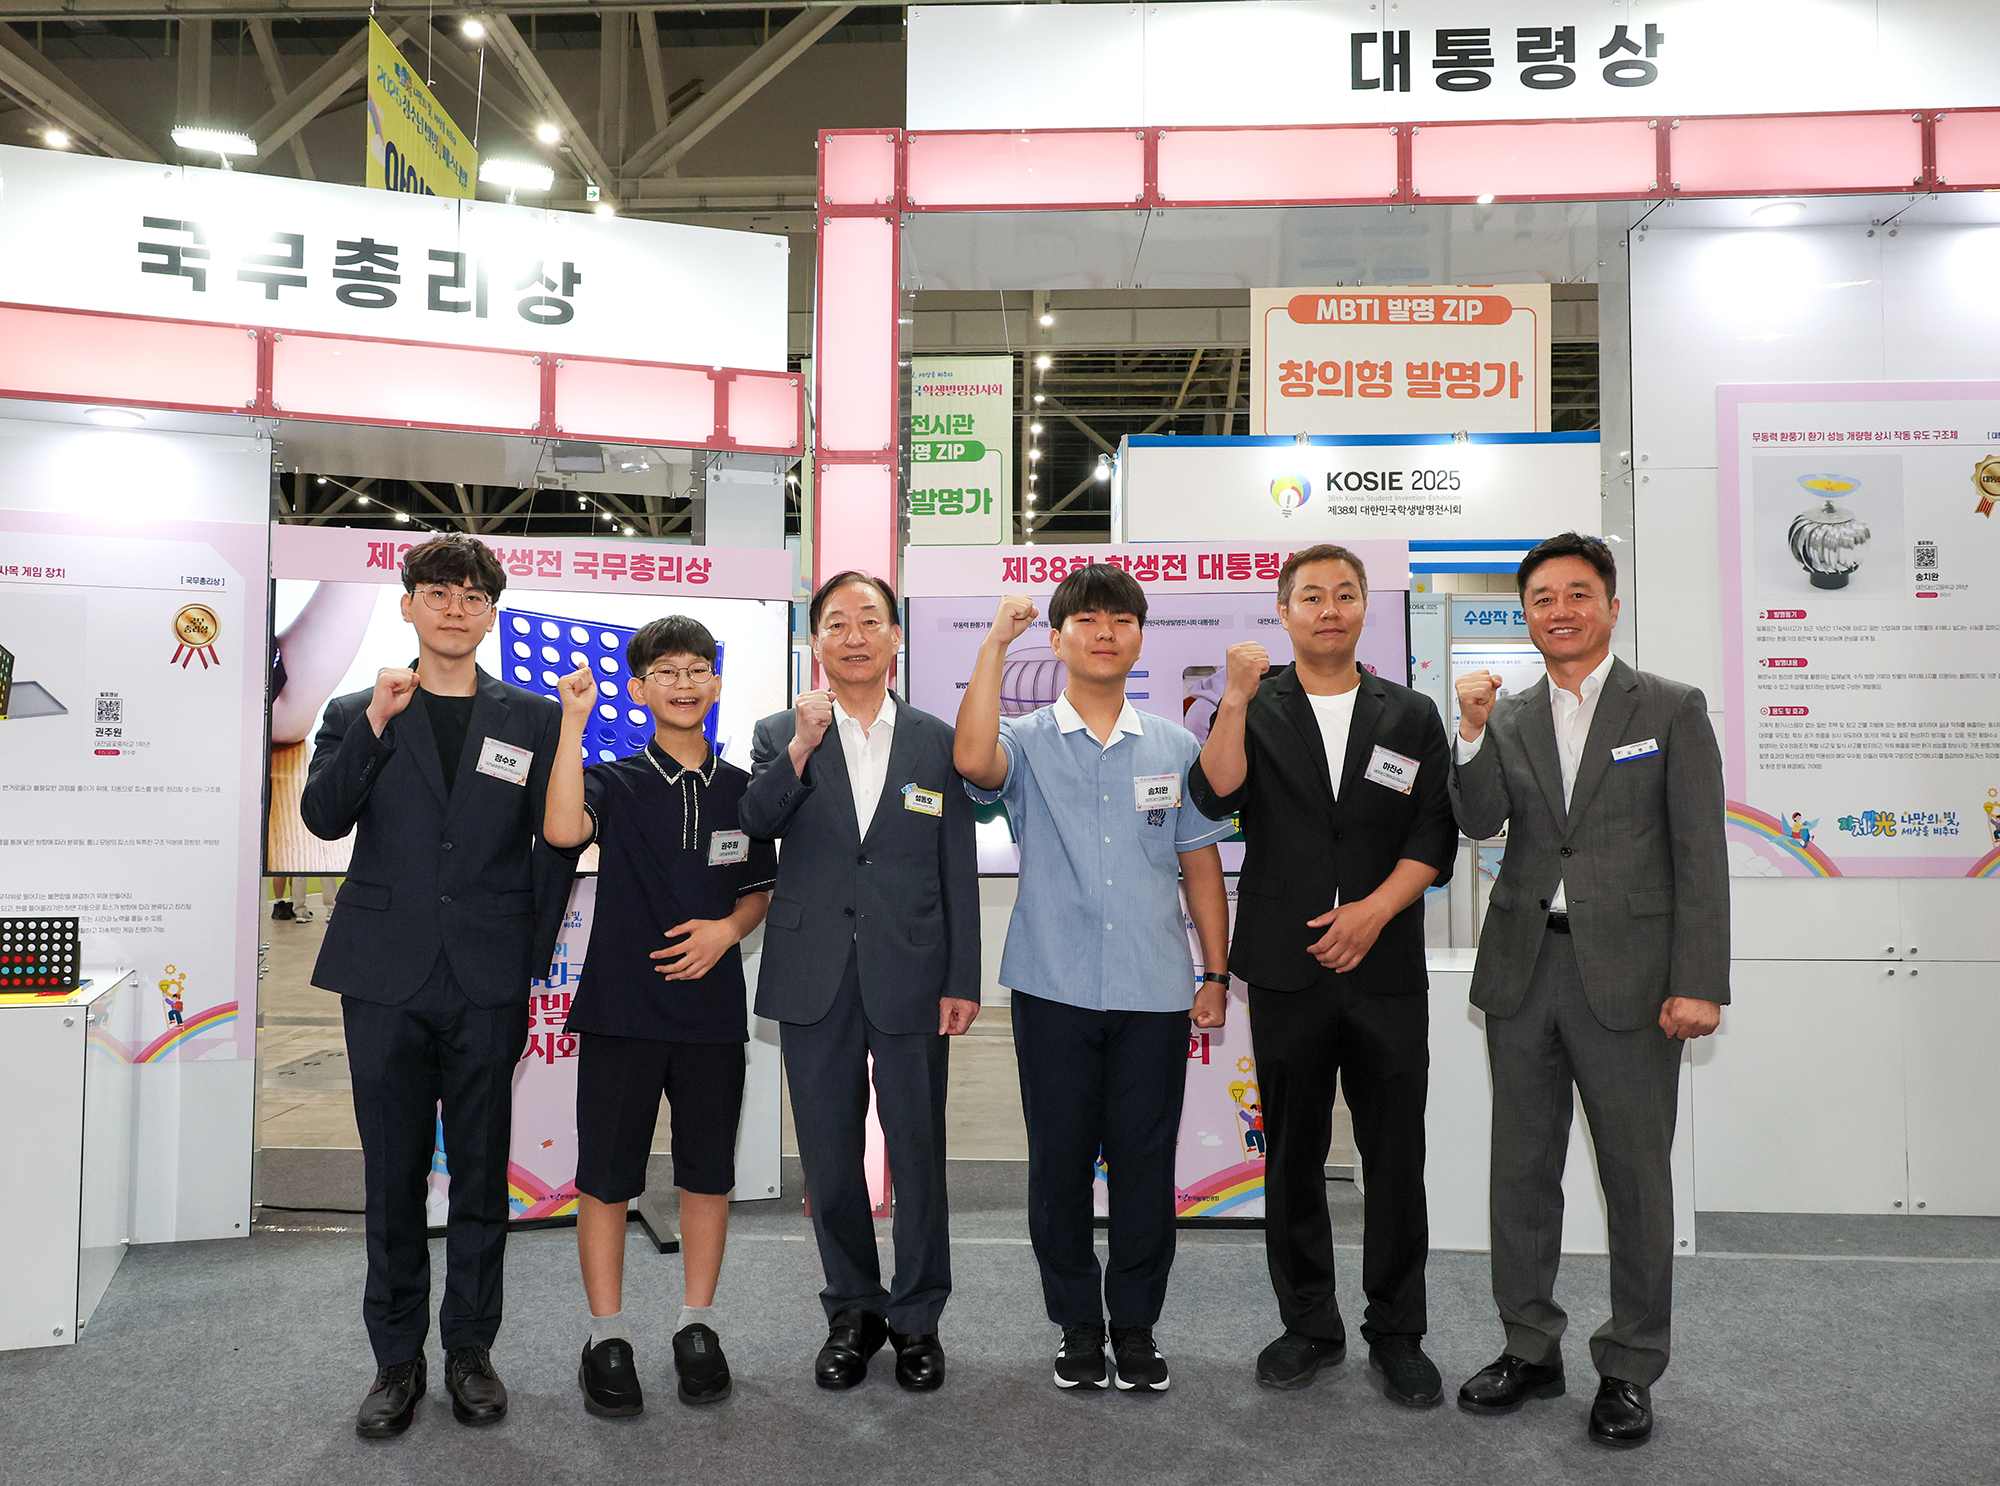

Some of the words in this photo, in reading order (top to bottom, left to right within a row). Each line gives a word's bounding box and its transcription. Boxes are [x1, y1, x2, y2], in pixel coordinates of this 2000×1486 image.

[1350, 23, 1665, 93] 대통령상
[385, 140, 436, 196] 아이
[137, 215, 582, 325] 국무총리상
[1316, 299, 1379, 321] MBTI
[1388, 298, 1435, 322] 발명
[1442, 299, 1483, 321] ZIP
[1278, 360, 1393, 398] 창의형
[1406, 360, 1524, 399] 발명가
[911, 414, 975, 436] 전시관
[1752, 432, 1778, 442] 무동력
[1780, 432, 1806, 442] 환풍기
[1808, 432, 1825, 441] 환기
[1827, 432, 1844, 442] 성능
[1874, 431, 1892, 441] 상시
[1894, 430, 1911, 441] 작동
[1913, 430, 1930, 440] 유도
[1932, 430, 1959, 440] 구조체
[911, 443, 931, 461] 명
[936, 443, 966, 460] ZIP
[1326, 471, 1403, 491] KOSIE
[1410, 470, 1461, 490] 2025
[912, 487, 994, 516] 발명가
[1327, 494, 1344, 502] 38th
[1345, 494, 1365, 502] Korea
[1366, 494, 1393, 502] Student
[1395, 494, 1426, 502] Invention
[1428, 494, 1462, 502] Exhibition
[1327, 504, 1358, 516] 제38회
[1360, 504, 1462, 516] 대한민국학생발명전시회
[21, 566, 43, 578] 게임
[45, 567, 66, 579] 장치
[573, 550, 712, 584] 국무총리상
[1198, 551, 1292, 581] 대통령
[1916, 573, 1939, 582] 송치완
[1464, 610, 1508, 625] 수상작
[95, 727, 122, 738] 권주원
[494, 753, 517, 767] 정수호
[1148, 786, 1169, 796] 송치완
[1901, 811, 1939, 826] 나만의
[1901, 826, 1930, 837] 세상을
[1932, 826, 1960, 836] 비추다
